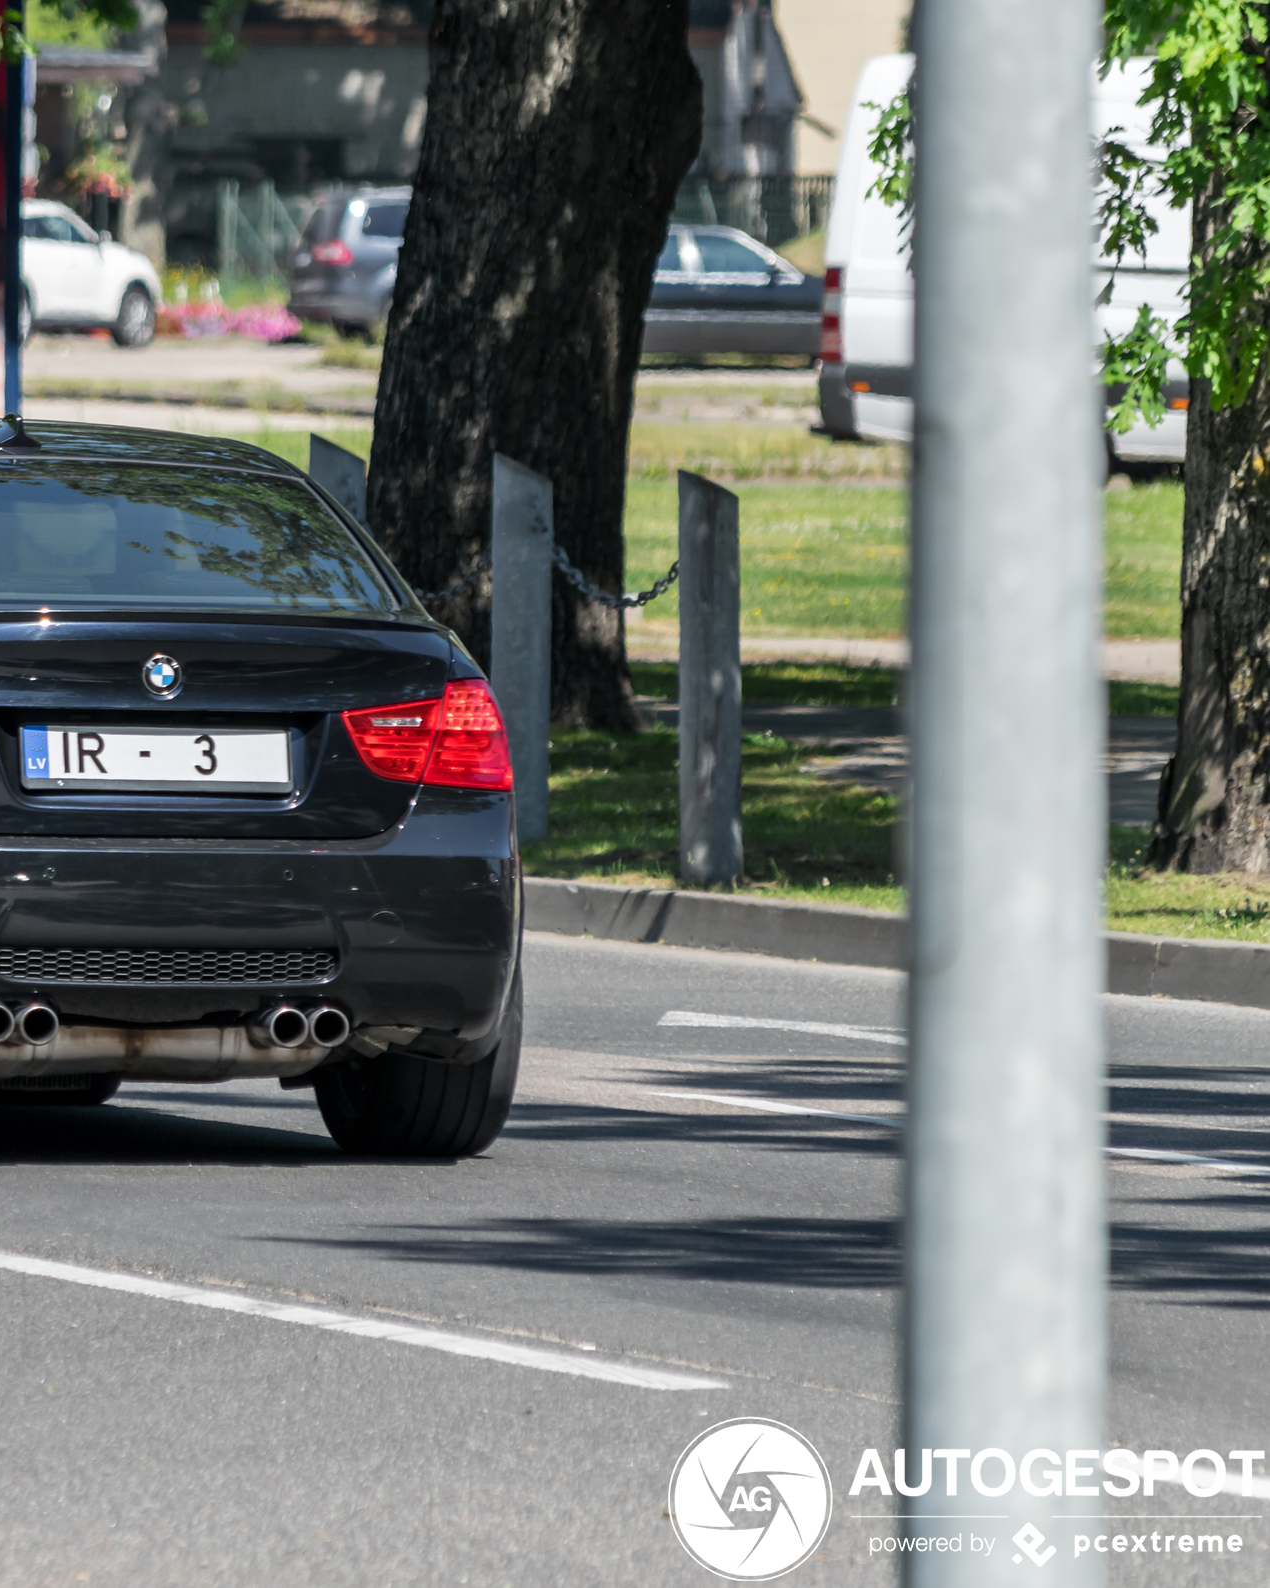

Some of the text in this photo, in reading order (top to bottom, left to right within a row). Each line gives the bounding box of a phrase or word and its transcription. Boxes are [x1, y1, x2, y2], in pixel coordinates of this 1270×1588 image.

[27, 757, 47, 770] LV
[62, 732, 108, 774] IR
[194, 734, 218, 776] 3
